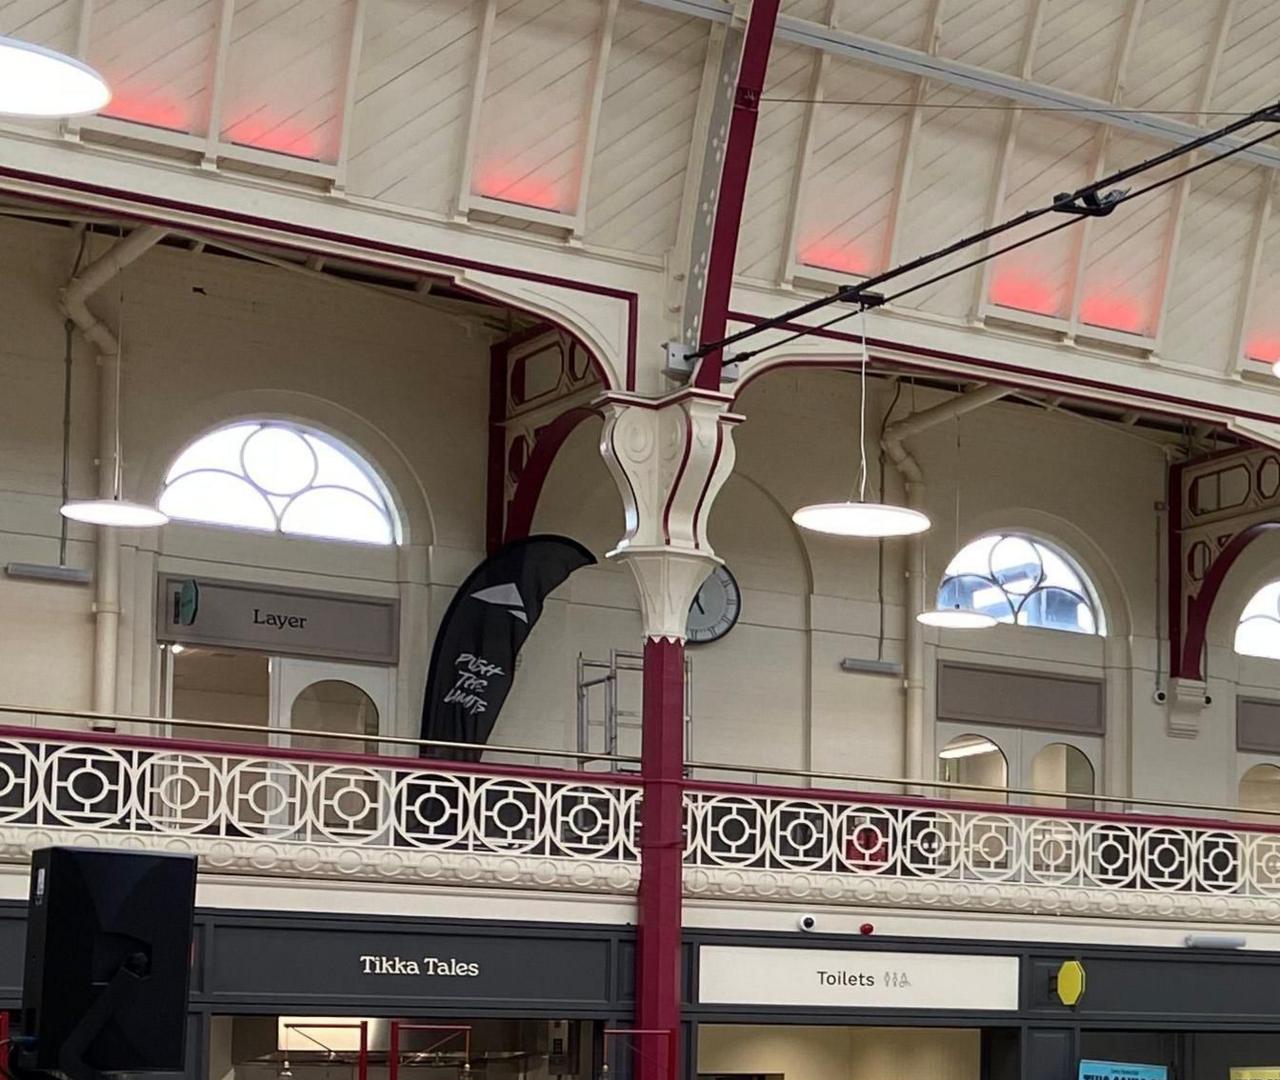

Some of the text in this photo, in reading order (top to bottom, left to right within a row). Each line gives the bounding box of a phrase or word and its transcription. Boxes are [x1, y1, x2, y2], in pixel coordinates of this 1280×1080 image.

[253, 609, 307, 630] Layer
[455, 653, 505, 676] PUSH
[455, 670, 488, 692] THE
[443, 688, 488, 715] LIMITS
[360, 956, 479, 976] Tikka Tales
[816, 970, 875, 986] Toilets
